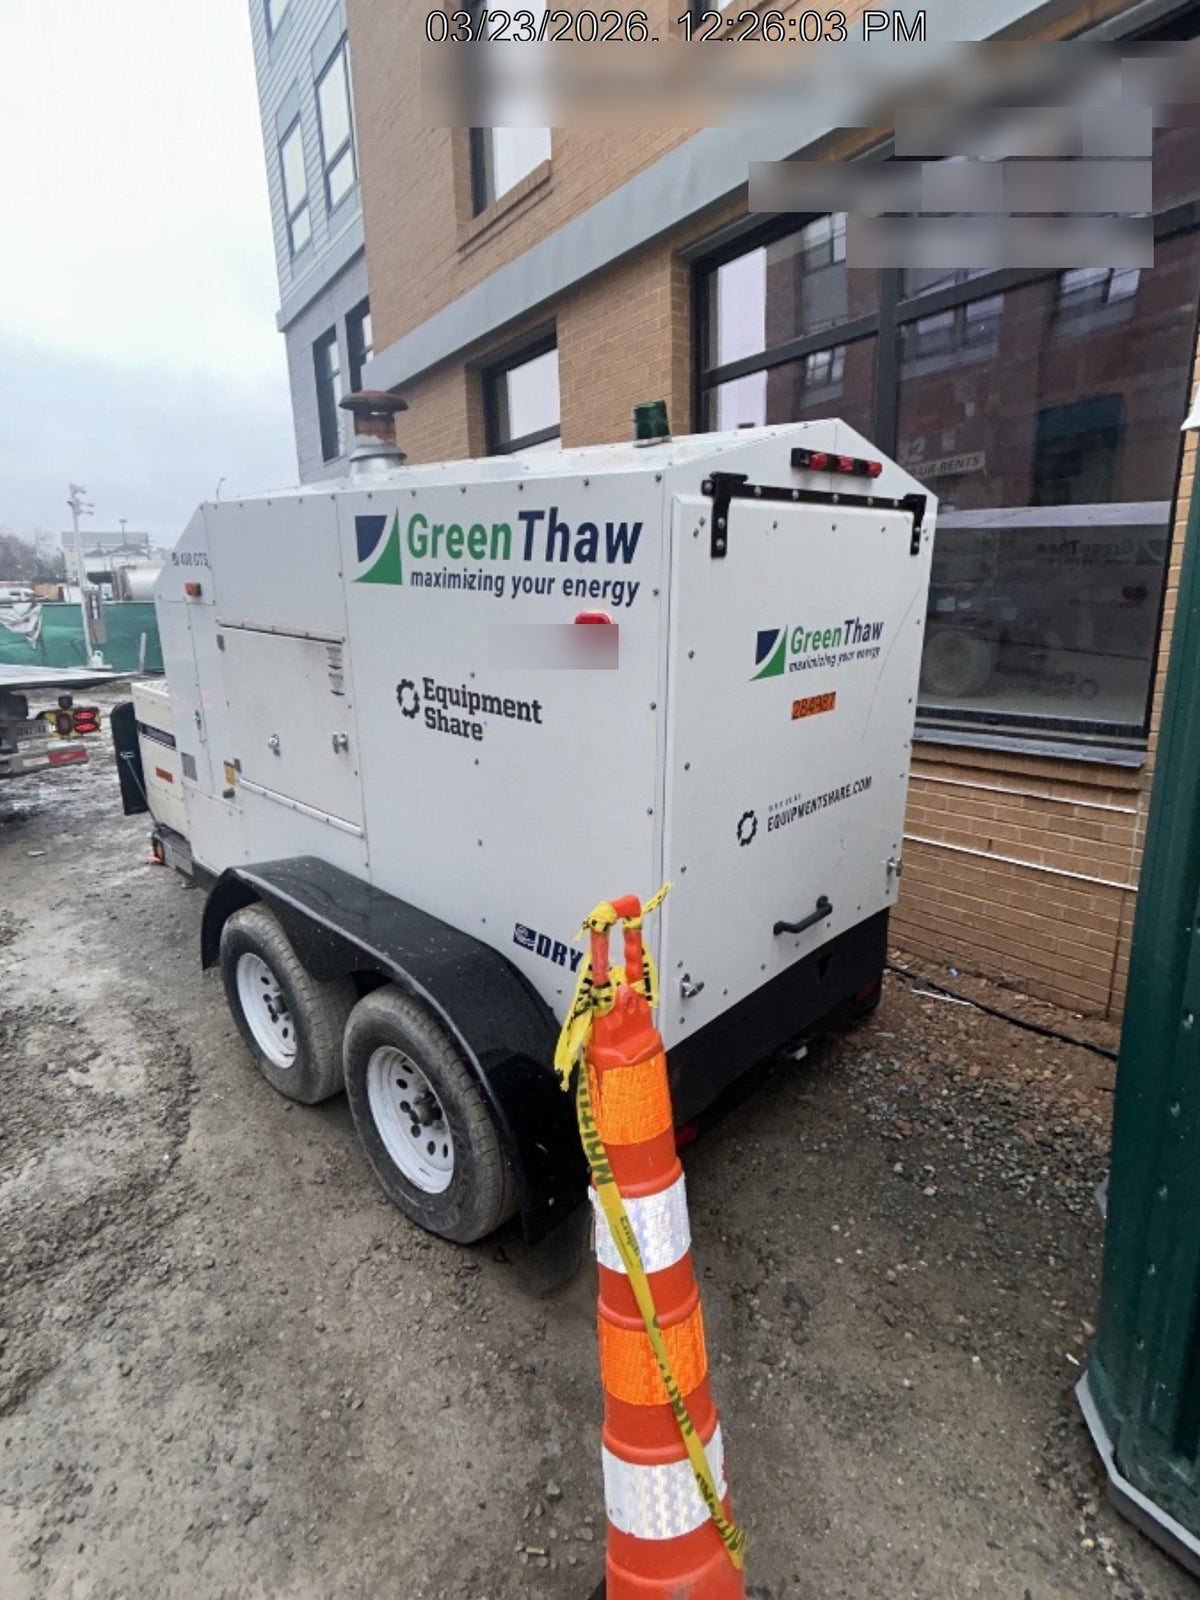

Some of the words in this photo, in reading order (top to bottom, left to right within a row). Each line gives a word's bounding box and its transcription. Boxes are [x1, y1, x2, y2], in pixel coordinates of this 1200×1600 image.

[407, 506, 644, 564] GreenThaw
[410, 566, 505, 598] maximizing
[511, 574, 556, 599] your
[562, 577, 640, 608] energy
[790, 616, 884, 655] GreenThaw
[789, 651, 837, 673] maximizing
[422, 676, 543, 725] Equipment
[424, 706, 483, 742] Share
[767, 775, 873, 833] EQUIPMENTSHARE.COM
